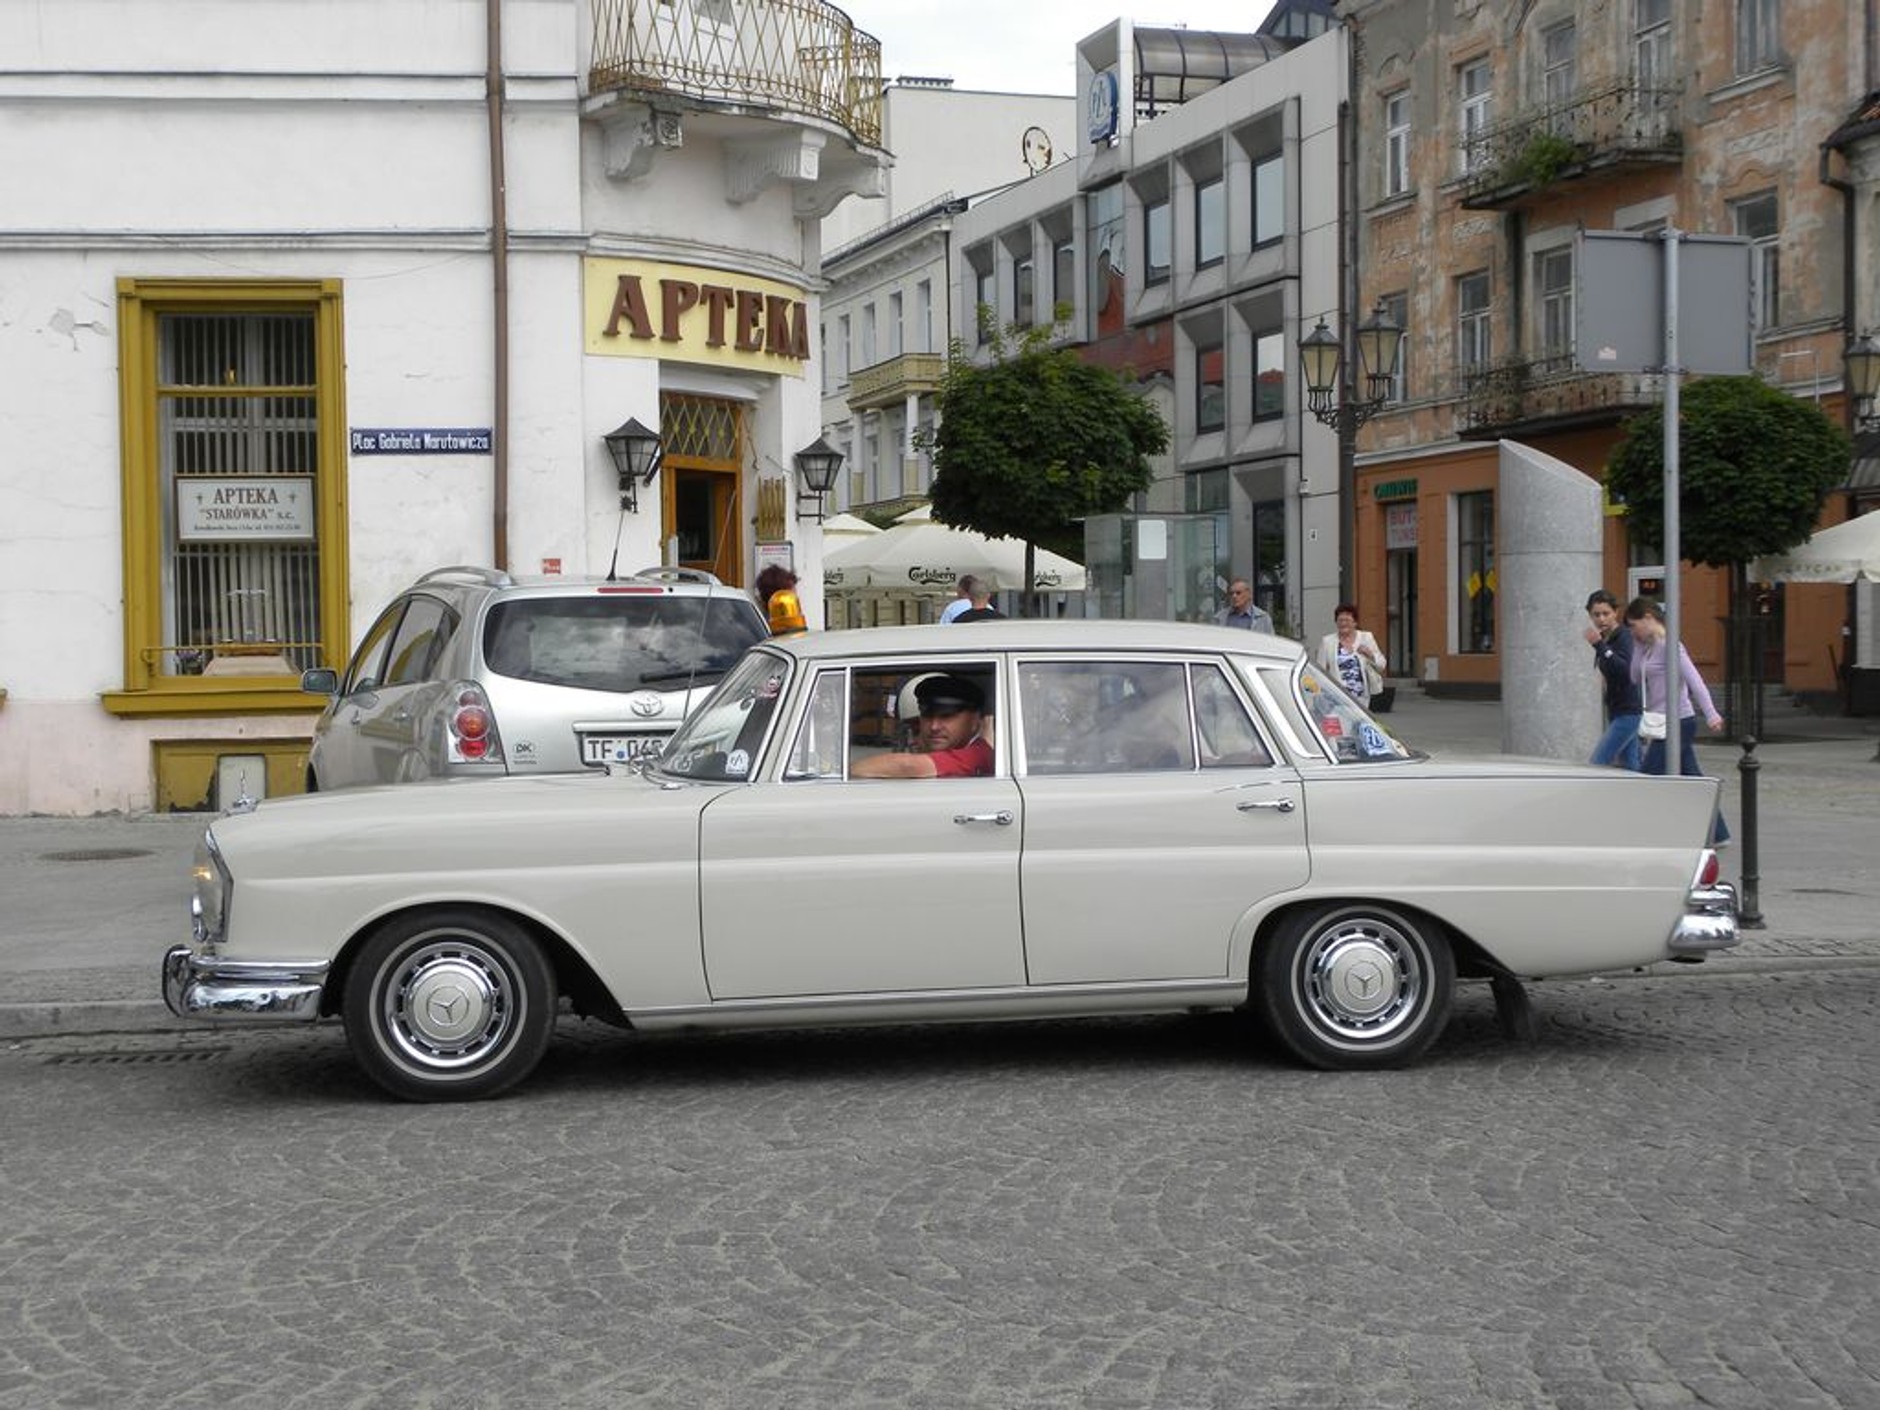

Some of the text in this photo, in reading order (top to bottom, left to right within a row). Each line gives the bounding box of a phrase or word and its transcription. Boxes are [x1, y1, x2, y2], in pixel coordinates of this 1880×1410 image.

[602, 274, 810, 361] APTEKA
[352, 432, 489, 449] Plac Gabriela Narutowicza
[213, 488, 279, 504] APTEKA
[909, 566, 956, 585] Carlsberg
